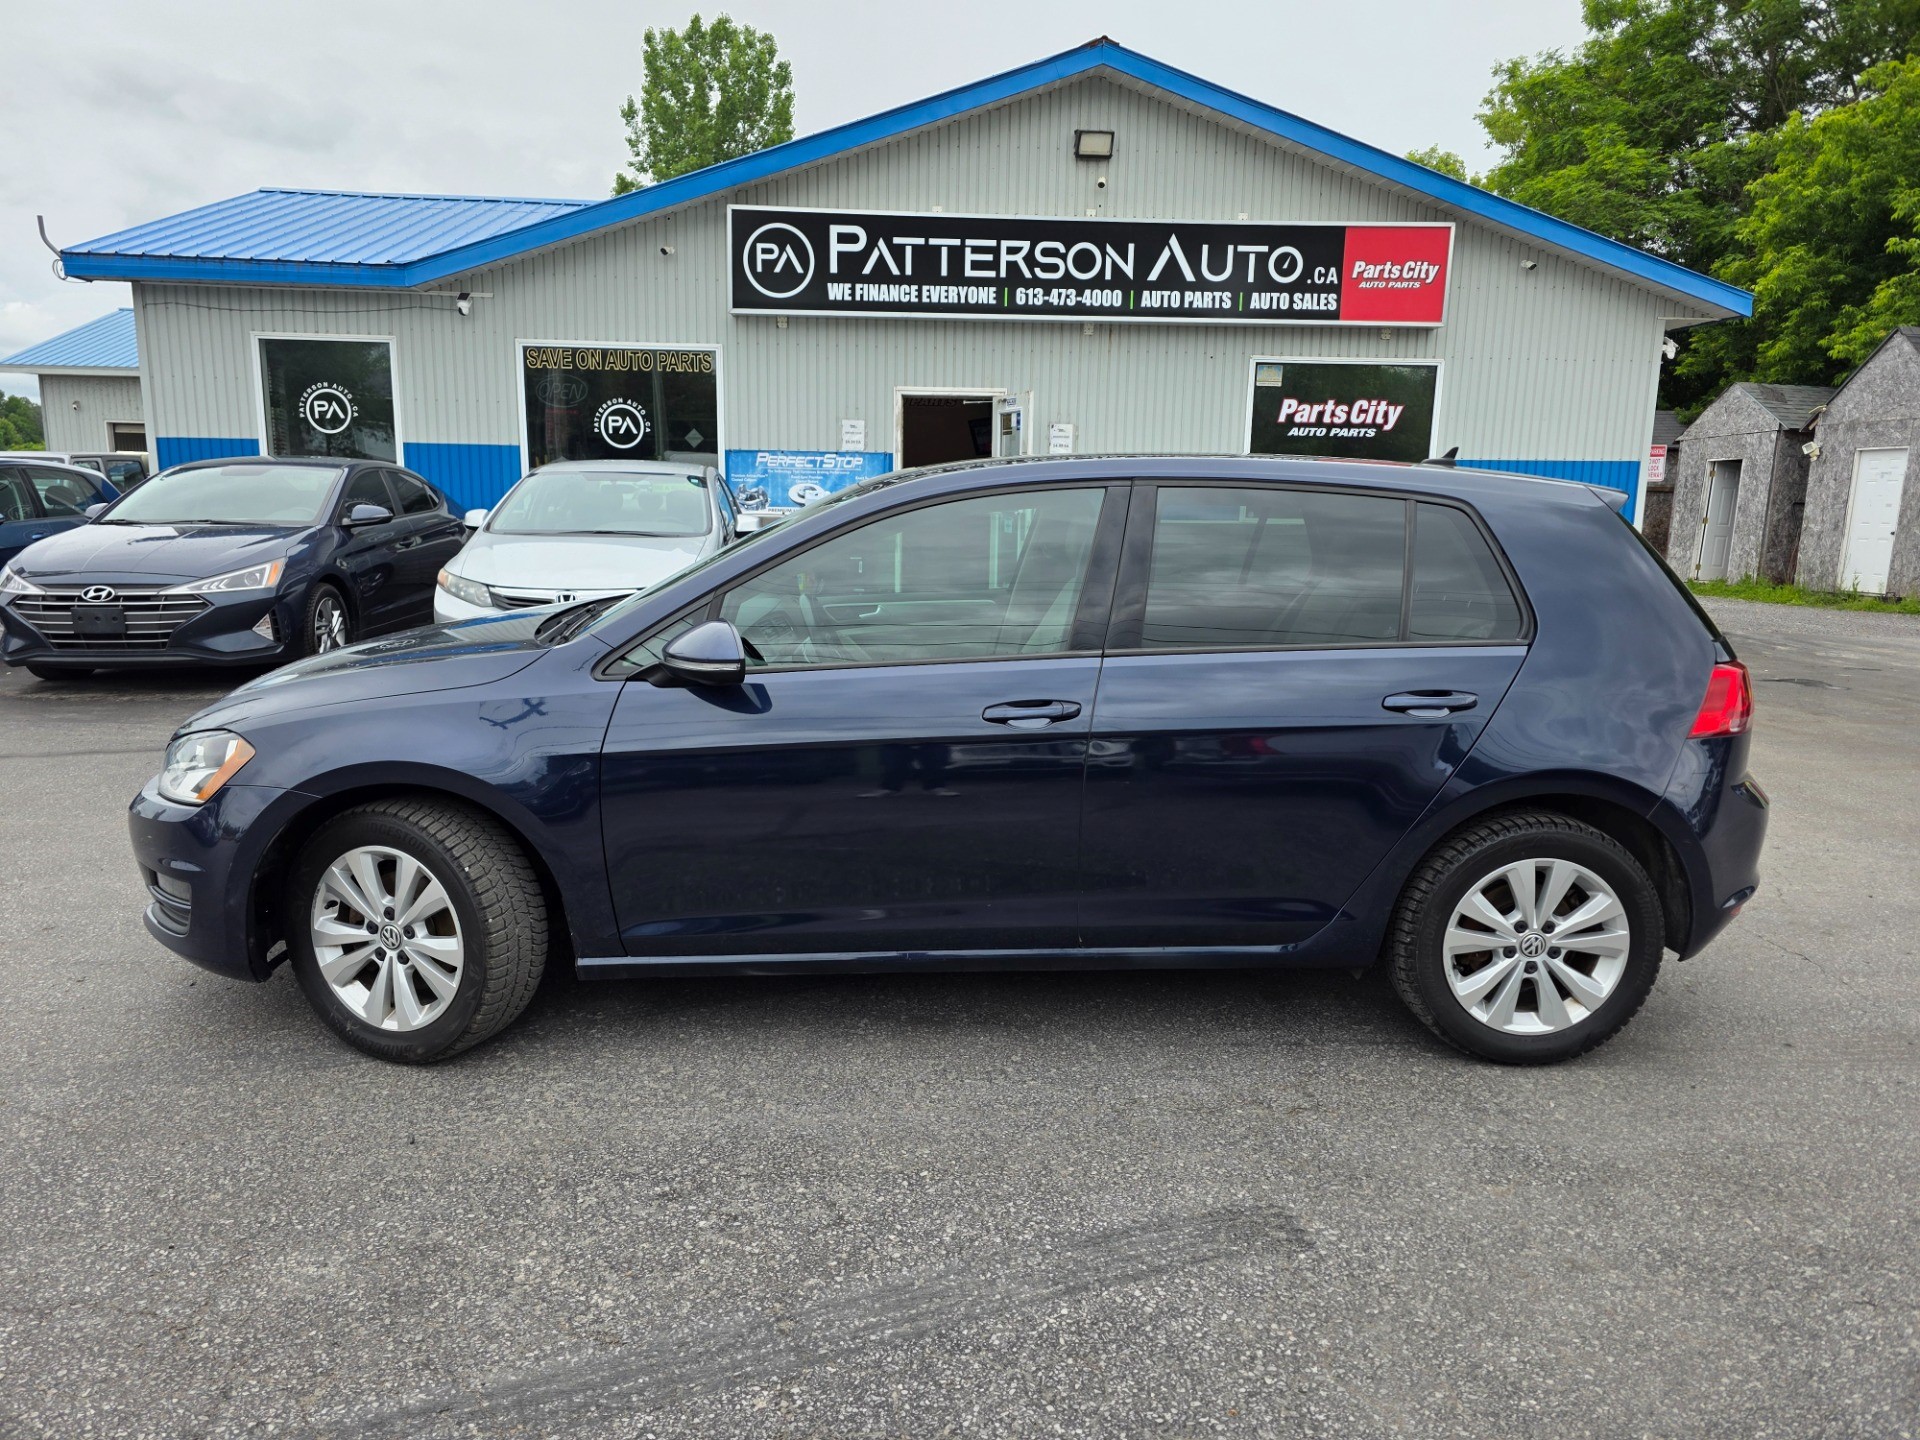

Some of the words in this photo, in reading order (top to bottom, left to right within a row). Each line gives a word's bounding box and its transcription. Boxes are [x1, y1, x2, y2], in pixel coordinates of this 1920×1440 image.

[829, 224, 1135, 280] PATTERSON
[1147, 232, 1304, 284] AUTO
[827, 282, 852, 301] WE
[855, 283, 918, 303] FINANCE
[922, 285, 997, 305] EVERYONE
[1358, 281, 1386, 289] AUTO
[1387, 281, 1421, 289] PARTS
[1016, 287, 1122, 307] 613-473-4000
[1141, 290, 1182, 309] AUTO
[1184, 291, 1232, 309] PARTS
[1250, 291, 1289, 310] AUTO
[1293, 292, 1337, 311] SALES
[527, 347, 573, 369] SAVE
[576, 349, 602, 370] ON
[605, 350, 653, 371] AUTO
[657, 351, 713, 373] PARTS
[298, 381, 329, 418] PATTERSON
[332, 383, 353, 399] AUTO
[539, 383, 583, 400] OPEN
[593, 397, 623, 433] PATTERSON
[626, 398, 646, 415] AUTO
[1287, 427, 1327, 437] AUTO
[1329, 427, 1377, 438] PARTS
